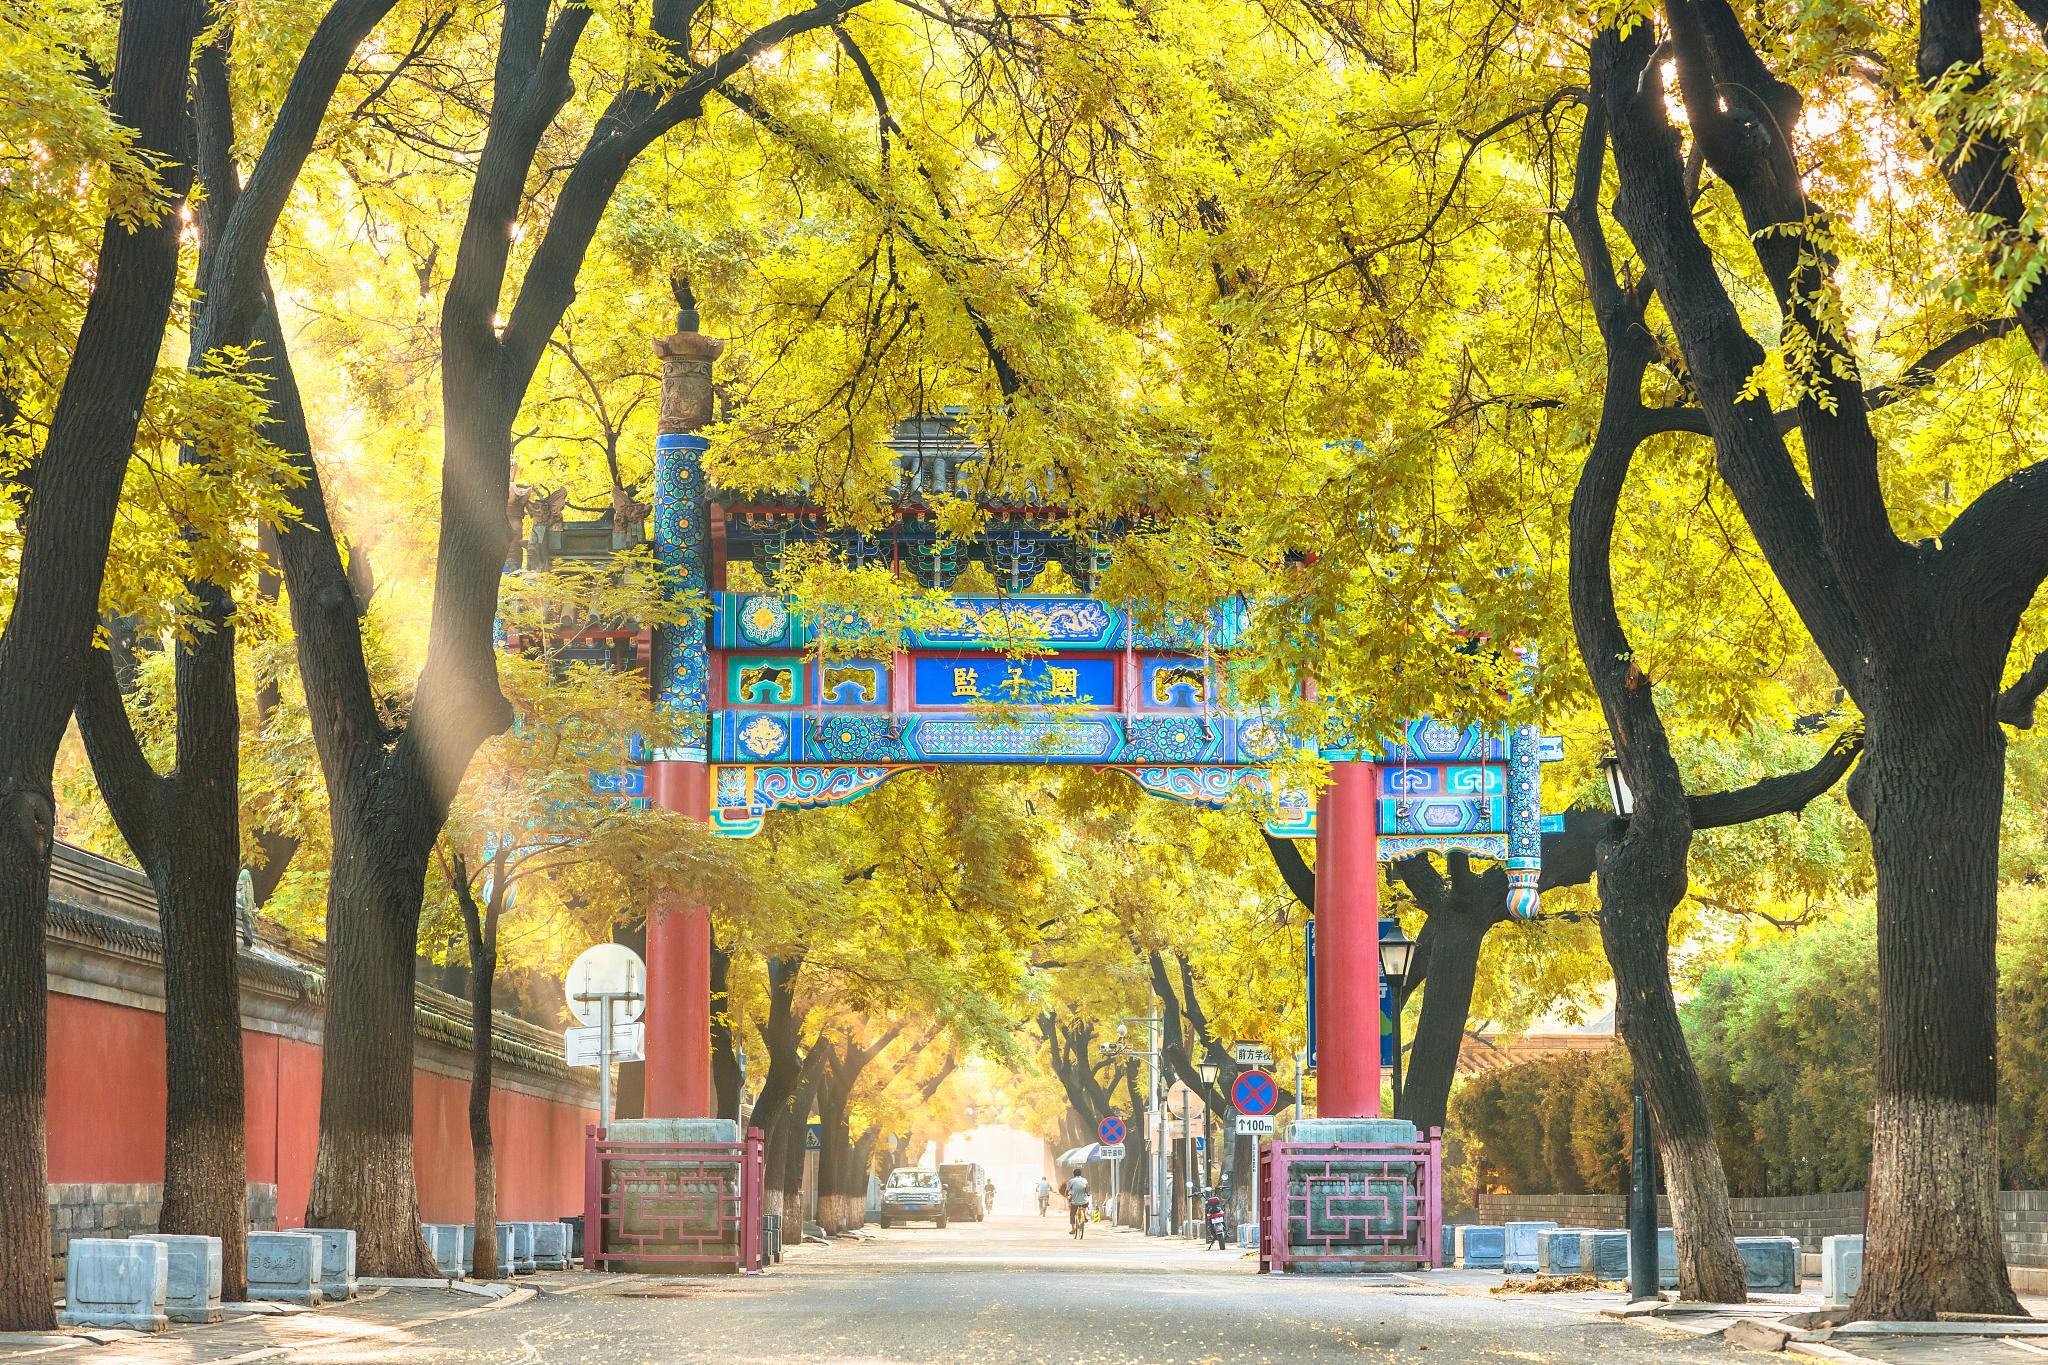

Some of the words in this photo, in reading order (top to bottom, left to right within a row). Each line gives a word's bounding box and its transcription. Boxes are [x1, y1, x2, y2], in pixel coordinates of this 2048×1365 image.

[1238, 1048, 1271, 1060] 前方学校
[1246, 1119, 1272, 1132] 100m
